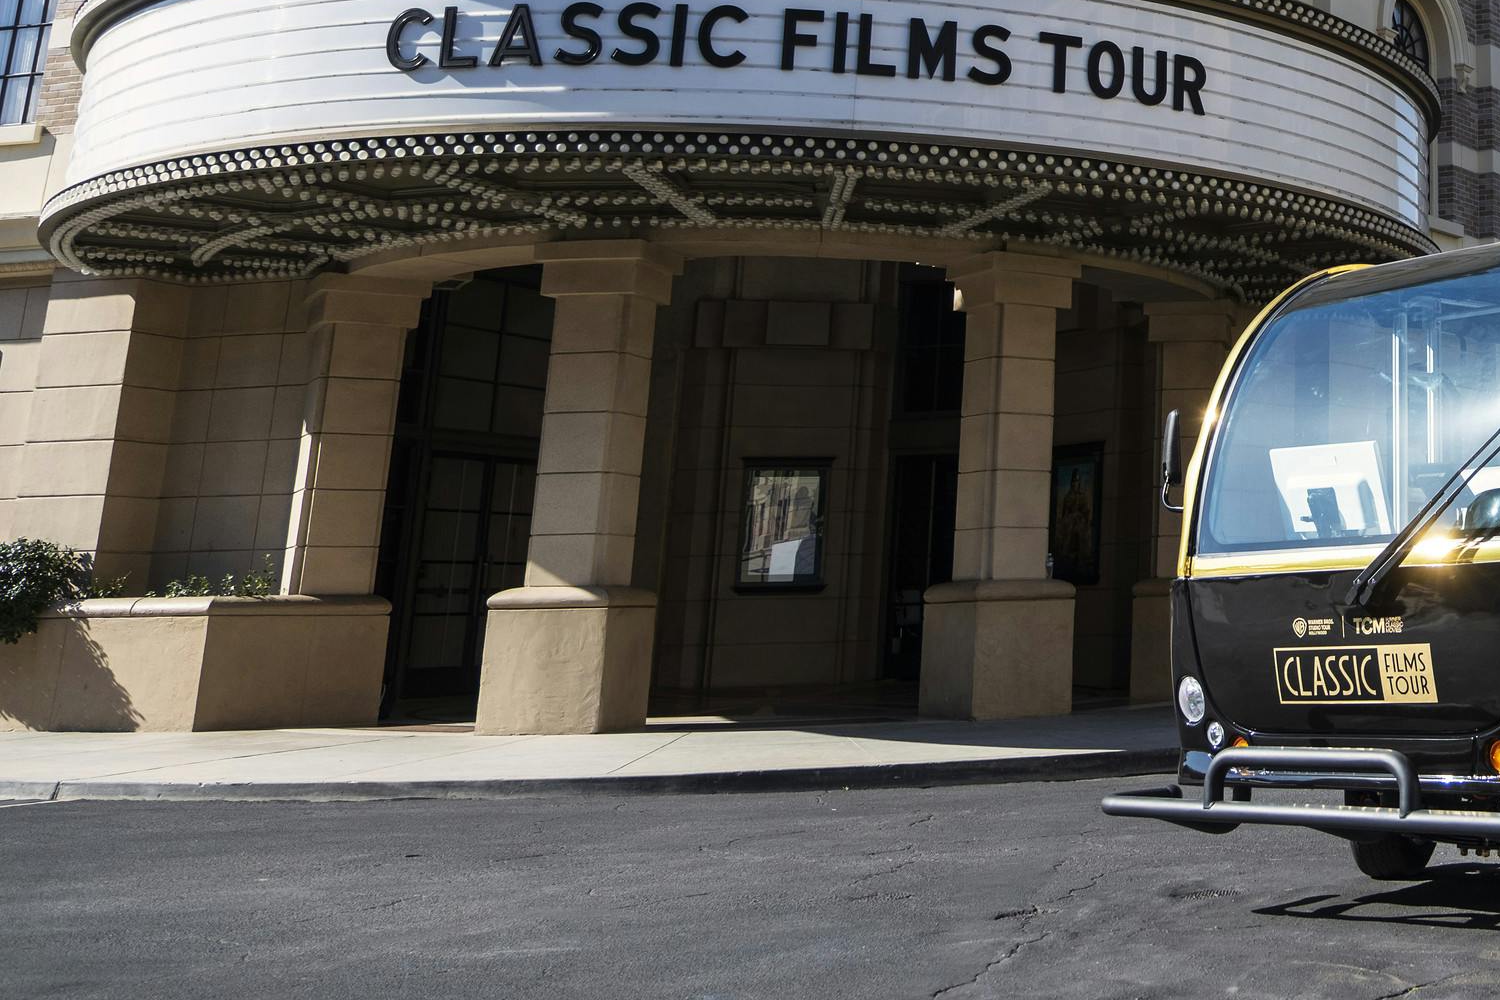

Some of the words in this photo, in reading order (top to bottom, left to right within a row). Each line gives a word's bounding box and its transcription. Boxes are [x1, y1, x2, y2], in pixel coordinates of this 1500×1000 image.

[386, 2, 750, 71] CLASSIC
[780, 8, 1012, 86] FILMS
[1039, 31, 1207, 116] TOUR
[1352, 616, 1385, 635] TCM
[1383, 652, 1426, 673] FILMS
[1283, 655, 1377, 696] CLASSIC
[1386, 675, 1430, 695] TOUR
